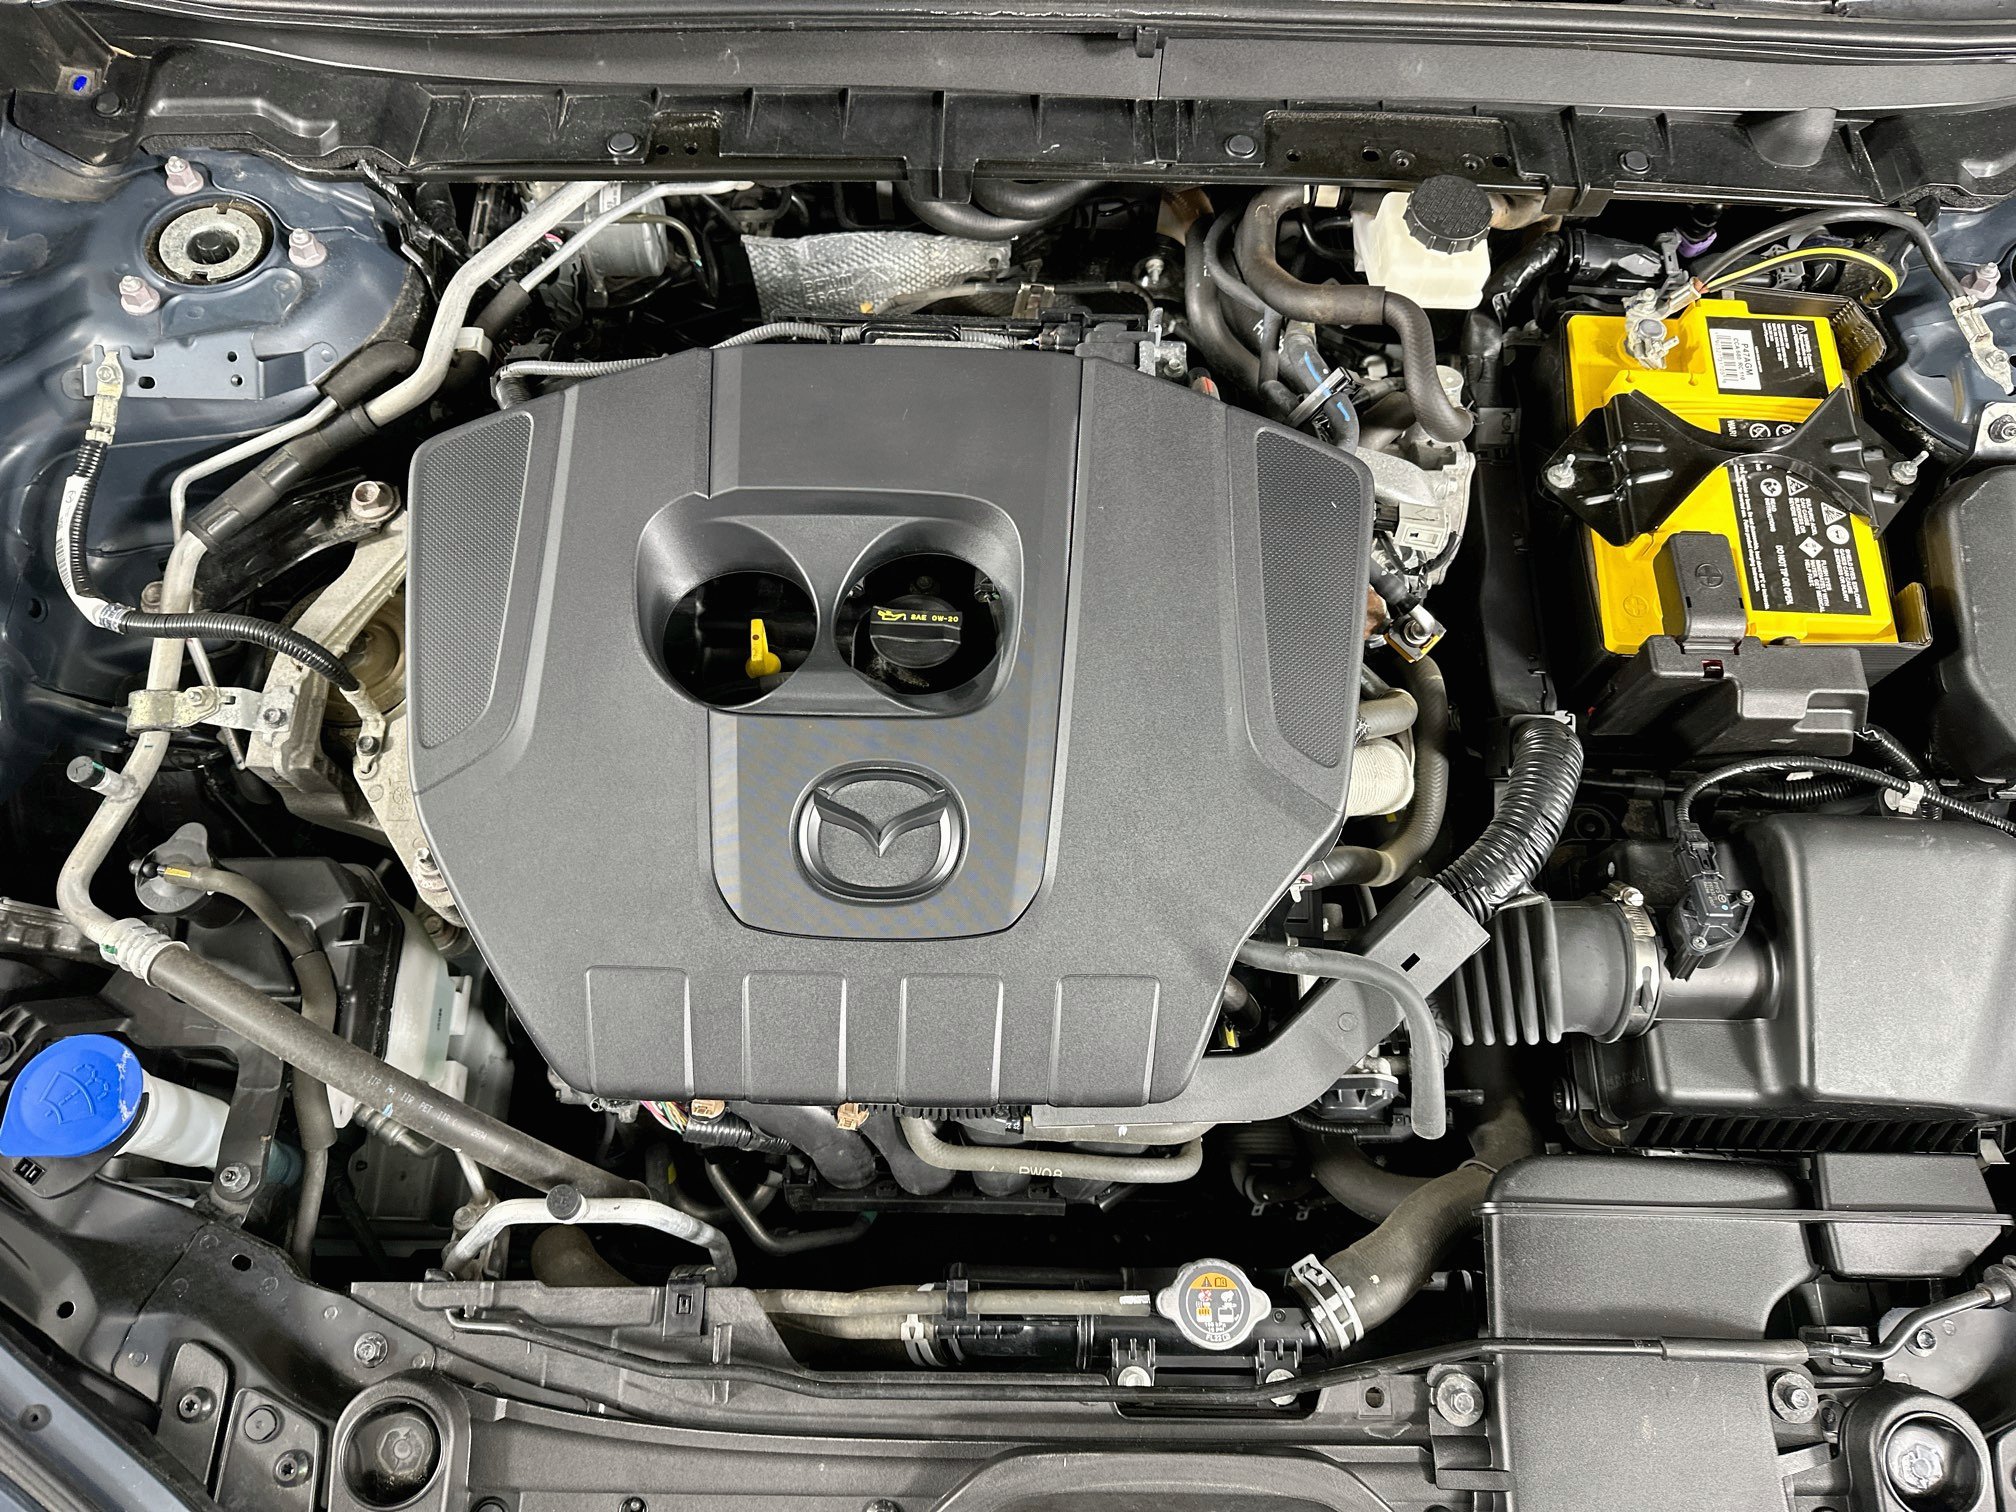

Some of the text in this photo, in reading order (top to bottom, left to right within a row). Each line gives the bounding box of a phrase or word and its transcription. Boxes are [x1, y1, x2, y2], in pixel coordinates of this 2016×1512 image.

[1741, 344, 1754, 375] P47AGM
[1775, 545, 1784, 554] DO
[1778, 555, 1787, 567] NOT
[1779, 568, 1789, 577] TIP
[1781, 577, 1790, 587] OR
